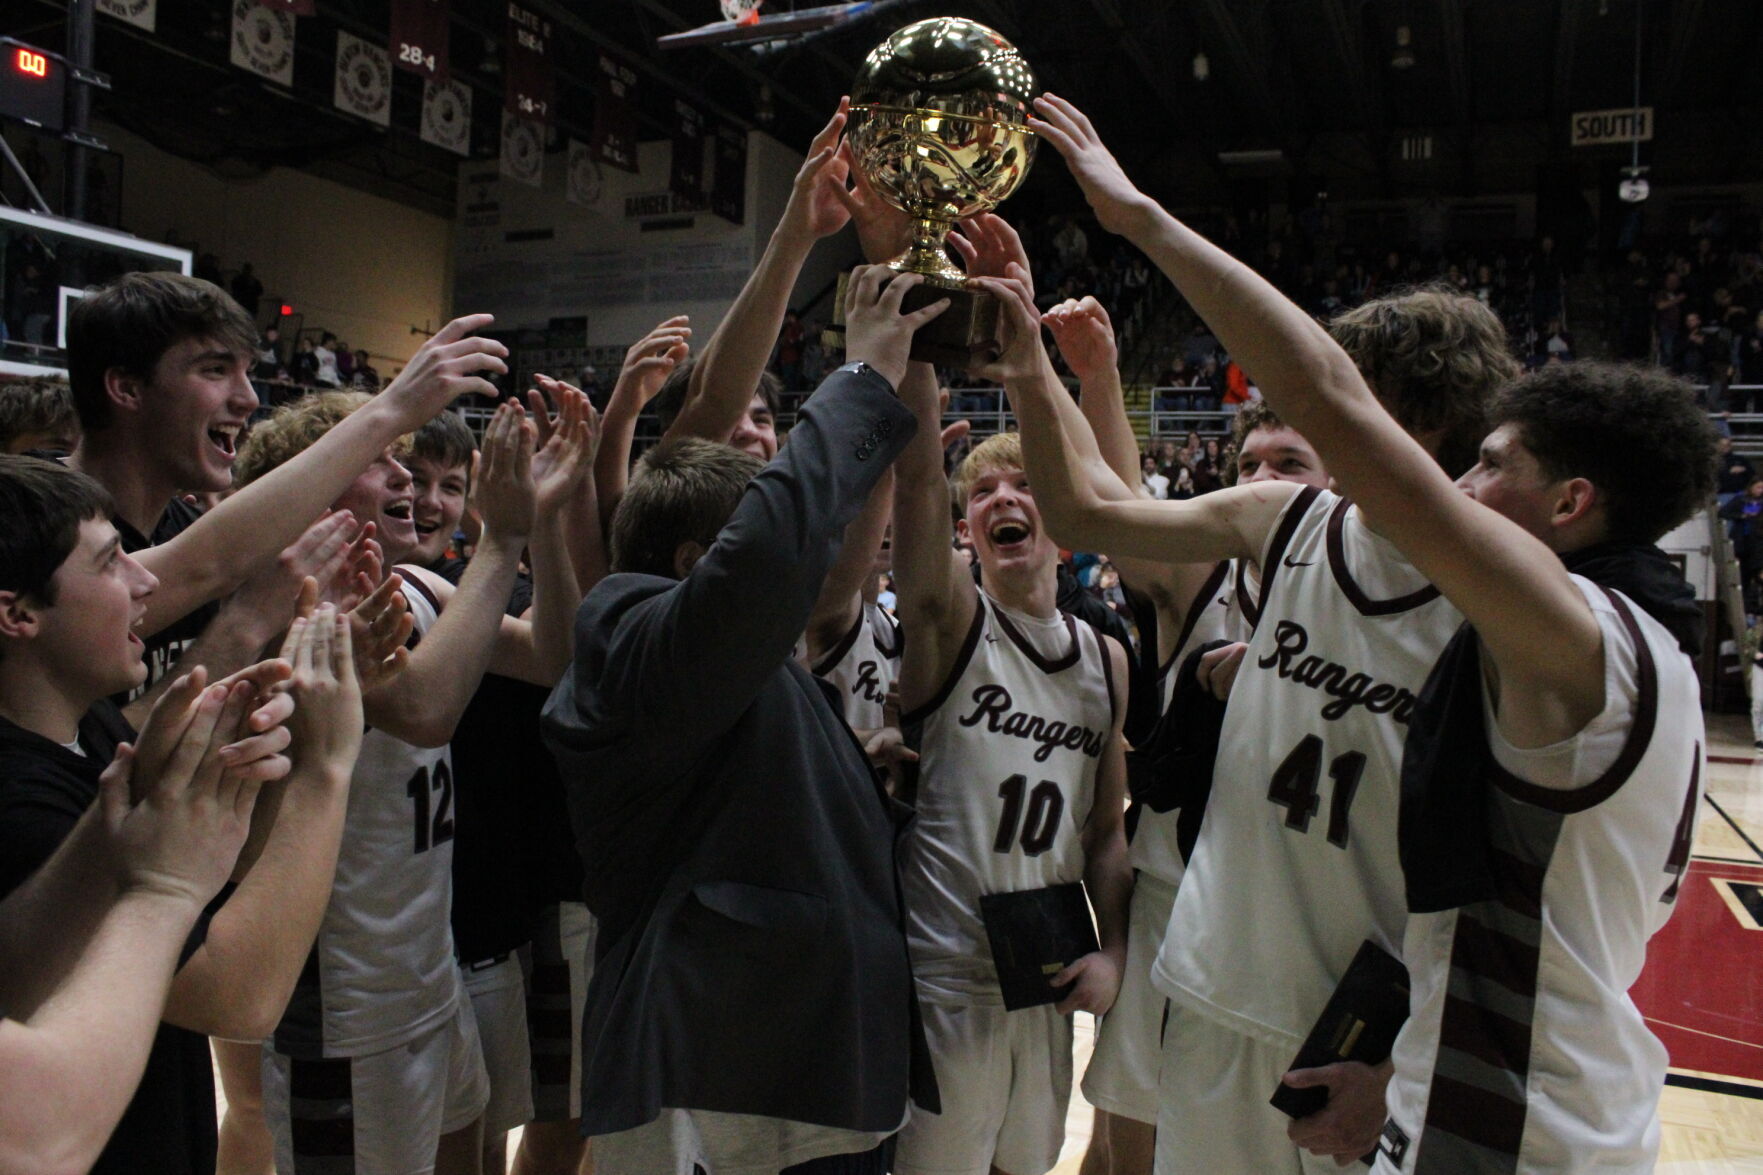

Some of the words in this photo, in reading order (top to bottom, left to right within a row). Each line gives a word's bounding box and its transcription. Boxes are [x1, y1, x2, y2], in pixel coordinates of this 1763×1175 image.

[398, 43, 435, 73] 28-4
[1258, 619, 1418, 726] Ranger
[958, 684, 1104, 763] Rangers
[407, 758, 455, 855] 12
[993, 773, 1065, 858] 10
[1266, 733, 1367, 850] 41
